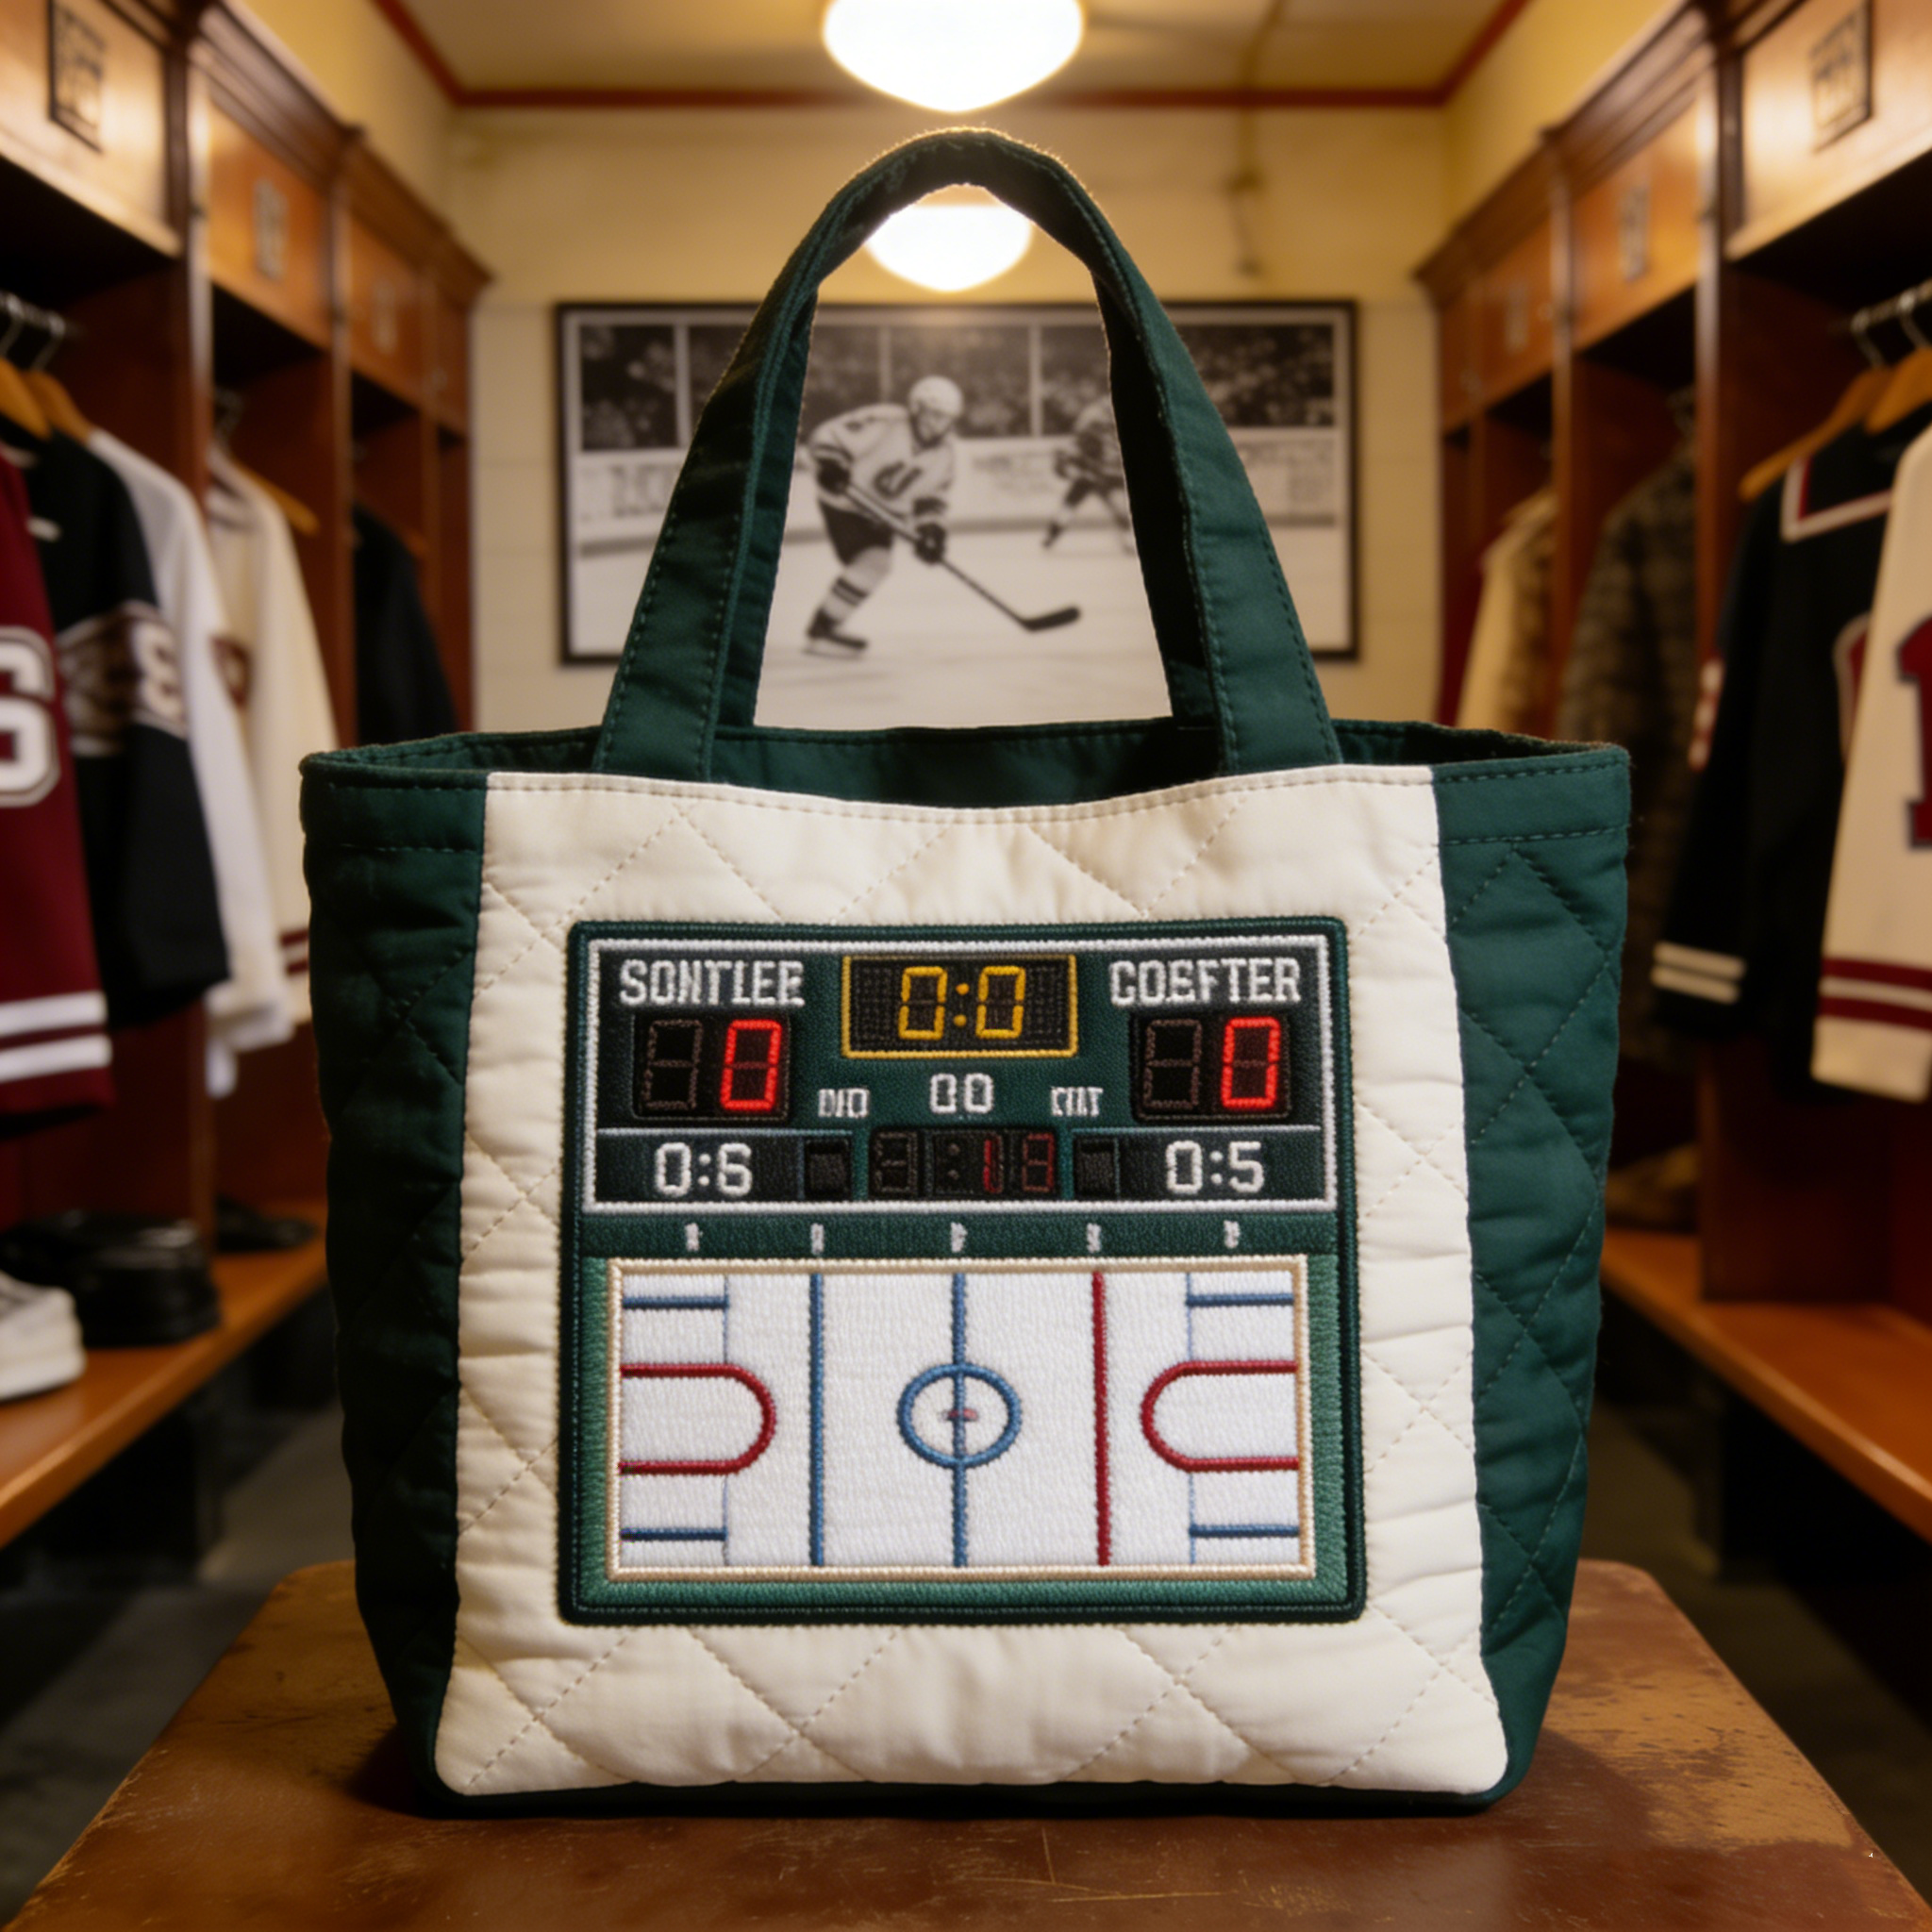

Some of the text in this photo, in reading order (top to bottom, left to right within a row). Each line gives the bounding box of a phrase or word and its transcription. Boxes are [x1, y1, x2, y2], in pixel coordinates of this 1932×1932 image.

[720, 1018, 782, 1111] 0
[1221, 1015, 1281, 1109] 0
[656, 1142, 753, 1197] 0:6
[1165, 1140, 1265, 1194] 0:5
